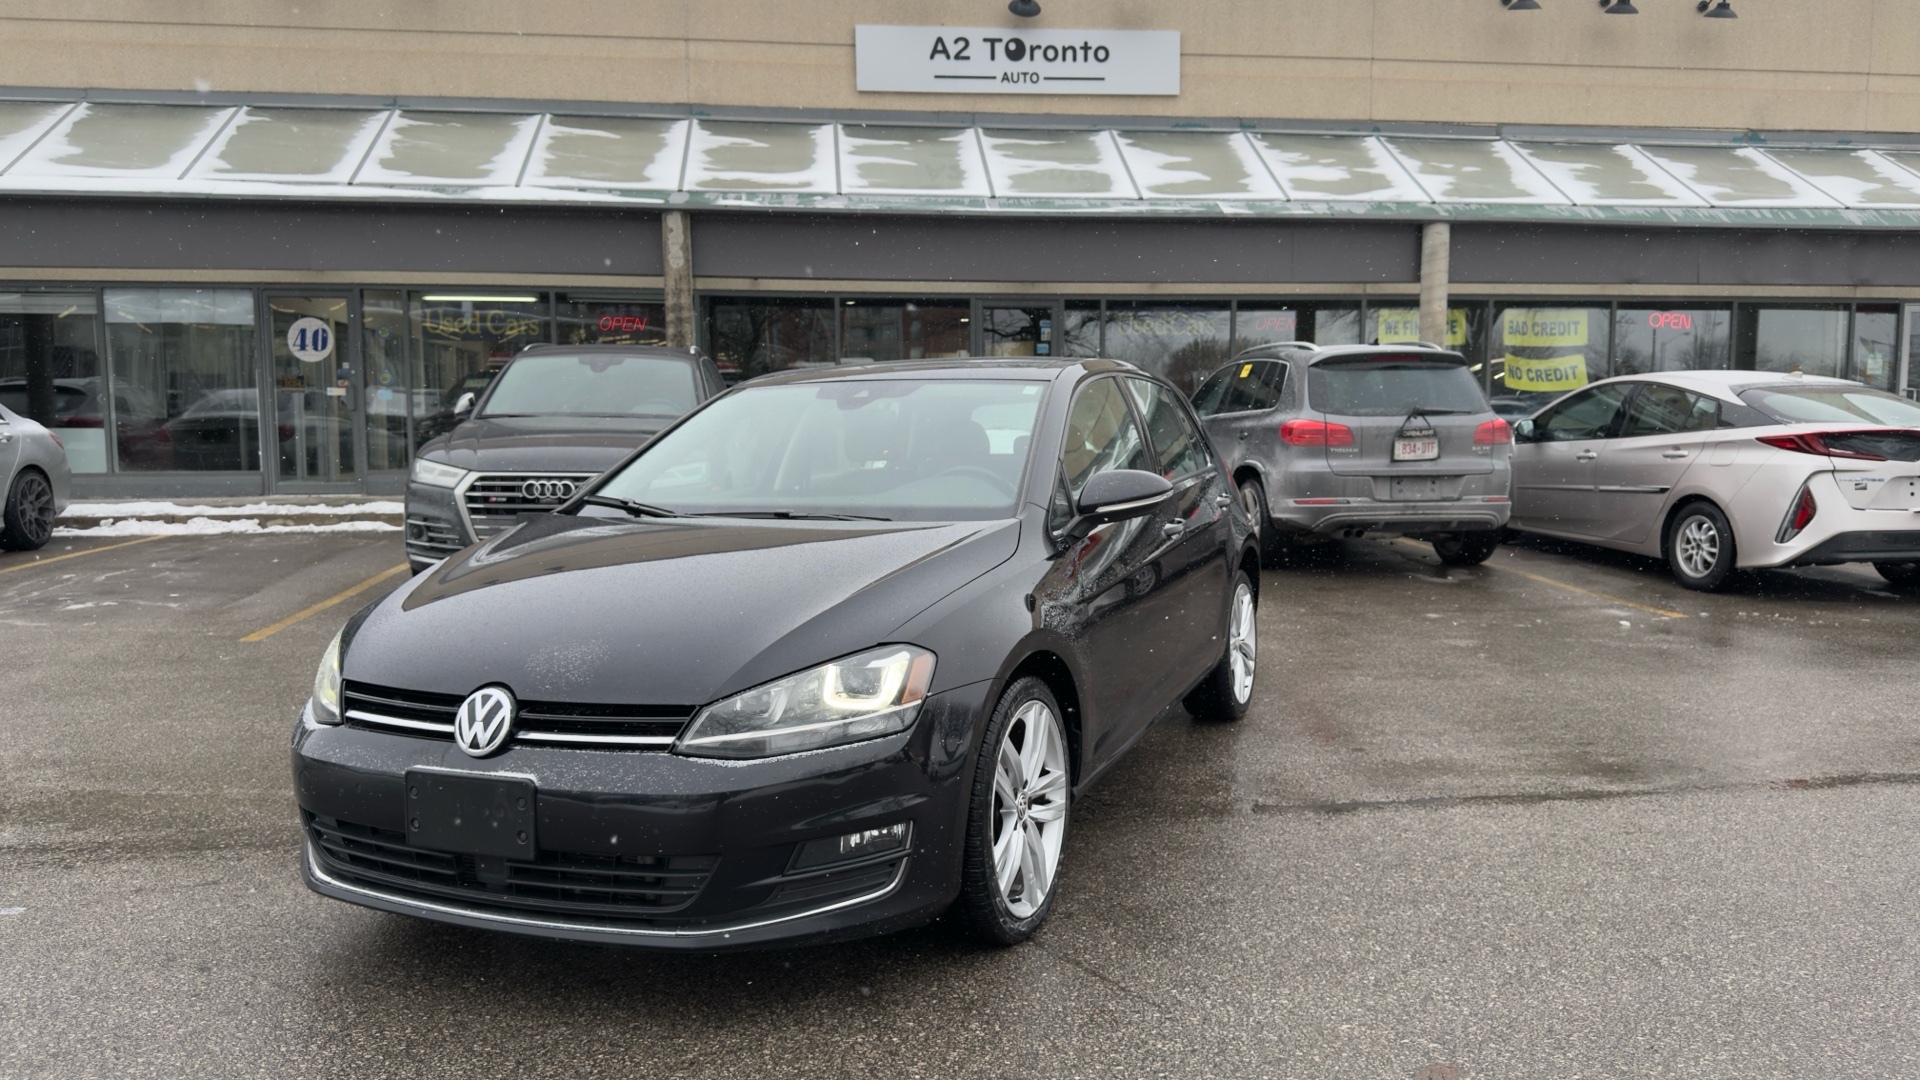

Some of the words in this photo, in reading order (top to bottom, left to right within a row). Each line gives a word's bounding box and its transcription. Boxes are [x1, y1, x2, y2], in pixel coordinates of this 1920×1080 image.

[929, 36, 971, 61] A2
[1000, 72, 1040, 84] AUTO
[424, 308, 480, 335] Used
[486, 309, 540, 335] Cars
[600, 316, 647, 332] OPEN
[1116, 310, 1167, 336] Used
[1170, 311, 1216, 336] Cars
[1254, 317, 1298, 332] OPEN
[1384, 320, 1399, 336] WE
[1508, 320, 1528, 337] BAD
[1532, 320, 1581, 337] CREDIT
[1649, 312, 1692, 329] OPEN
[292, 327, 329, 352] 40
[1508, 364, 1522, 380] NO
[1526, 365, 1579, 383] CREDIT
